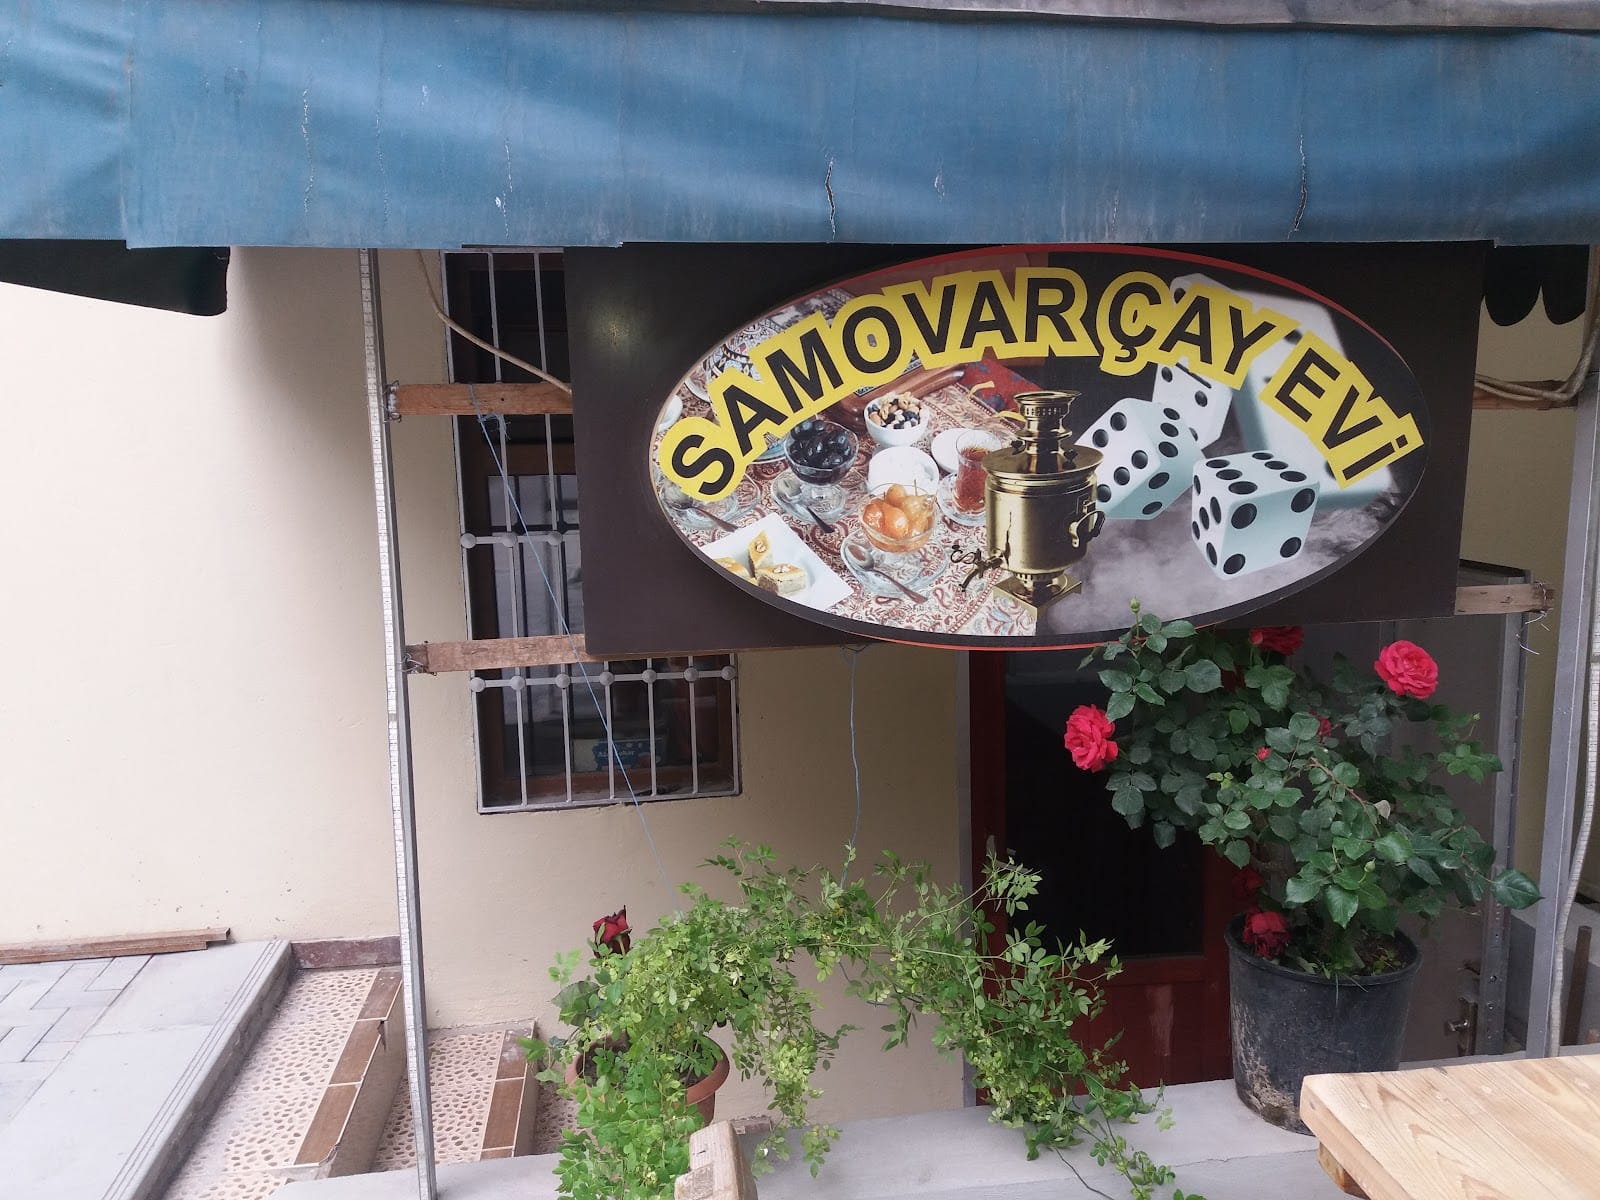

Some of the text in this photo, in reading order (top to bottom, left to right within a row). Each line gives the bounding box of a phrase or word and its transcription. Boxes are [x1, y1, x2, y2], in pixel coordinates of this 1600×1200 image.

[671, 277, 1409, 495] SAMOVAR ÇAY EVİ
